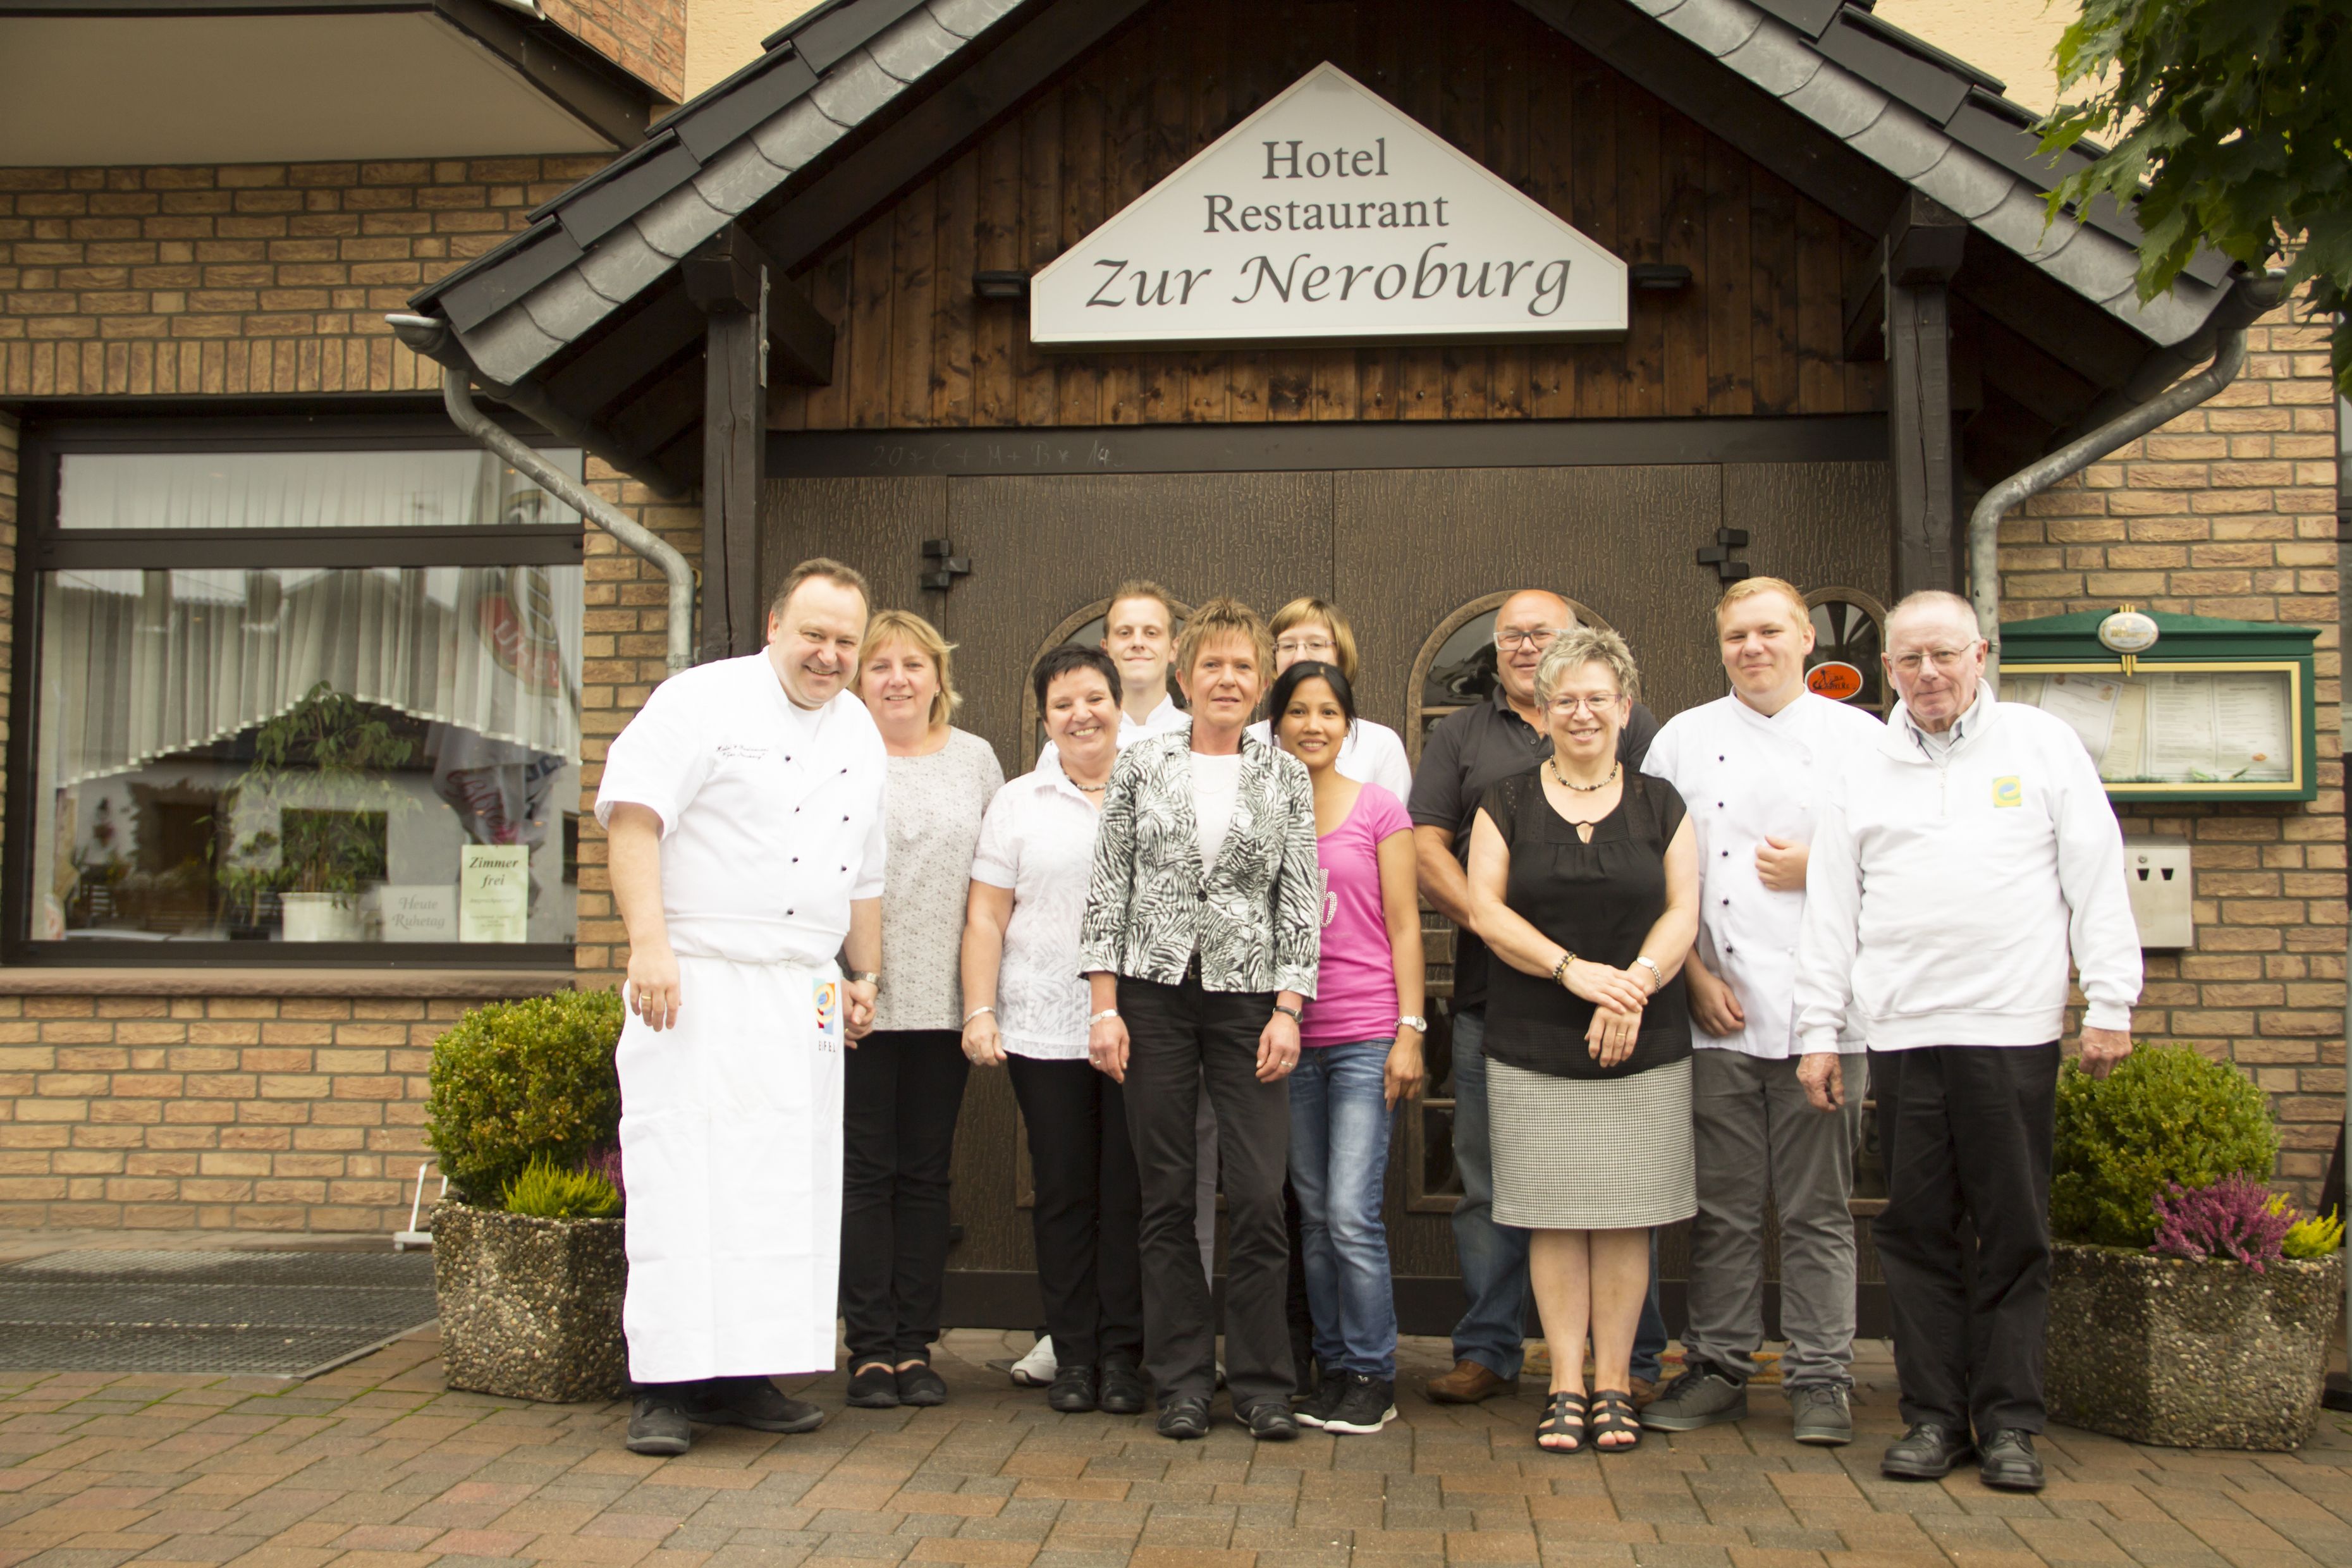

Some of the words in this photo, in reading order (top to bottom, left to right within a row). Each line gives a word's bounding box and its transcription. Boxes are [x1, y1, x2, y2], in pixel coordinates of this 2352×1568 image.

[1262, 138, 1388, 180] Hotel
[1203, 193, 1449, 233] Restaurant
[1085, 259, 1212, 309] Zur
[1232, 243, 1571, 317] Neroburg
[470, 857, 518, 868] Zimmer
[481, 874, 505, 888] frei
[400, 895, 438, 910] Heute
[393, 914, 445, 929] Ruhetag
